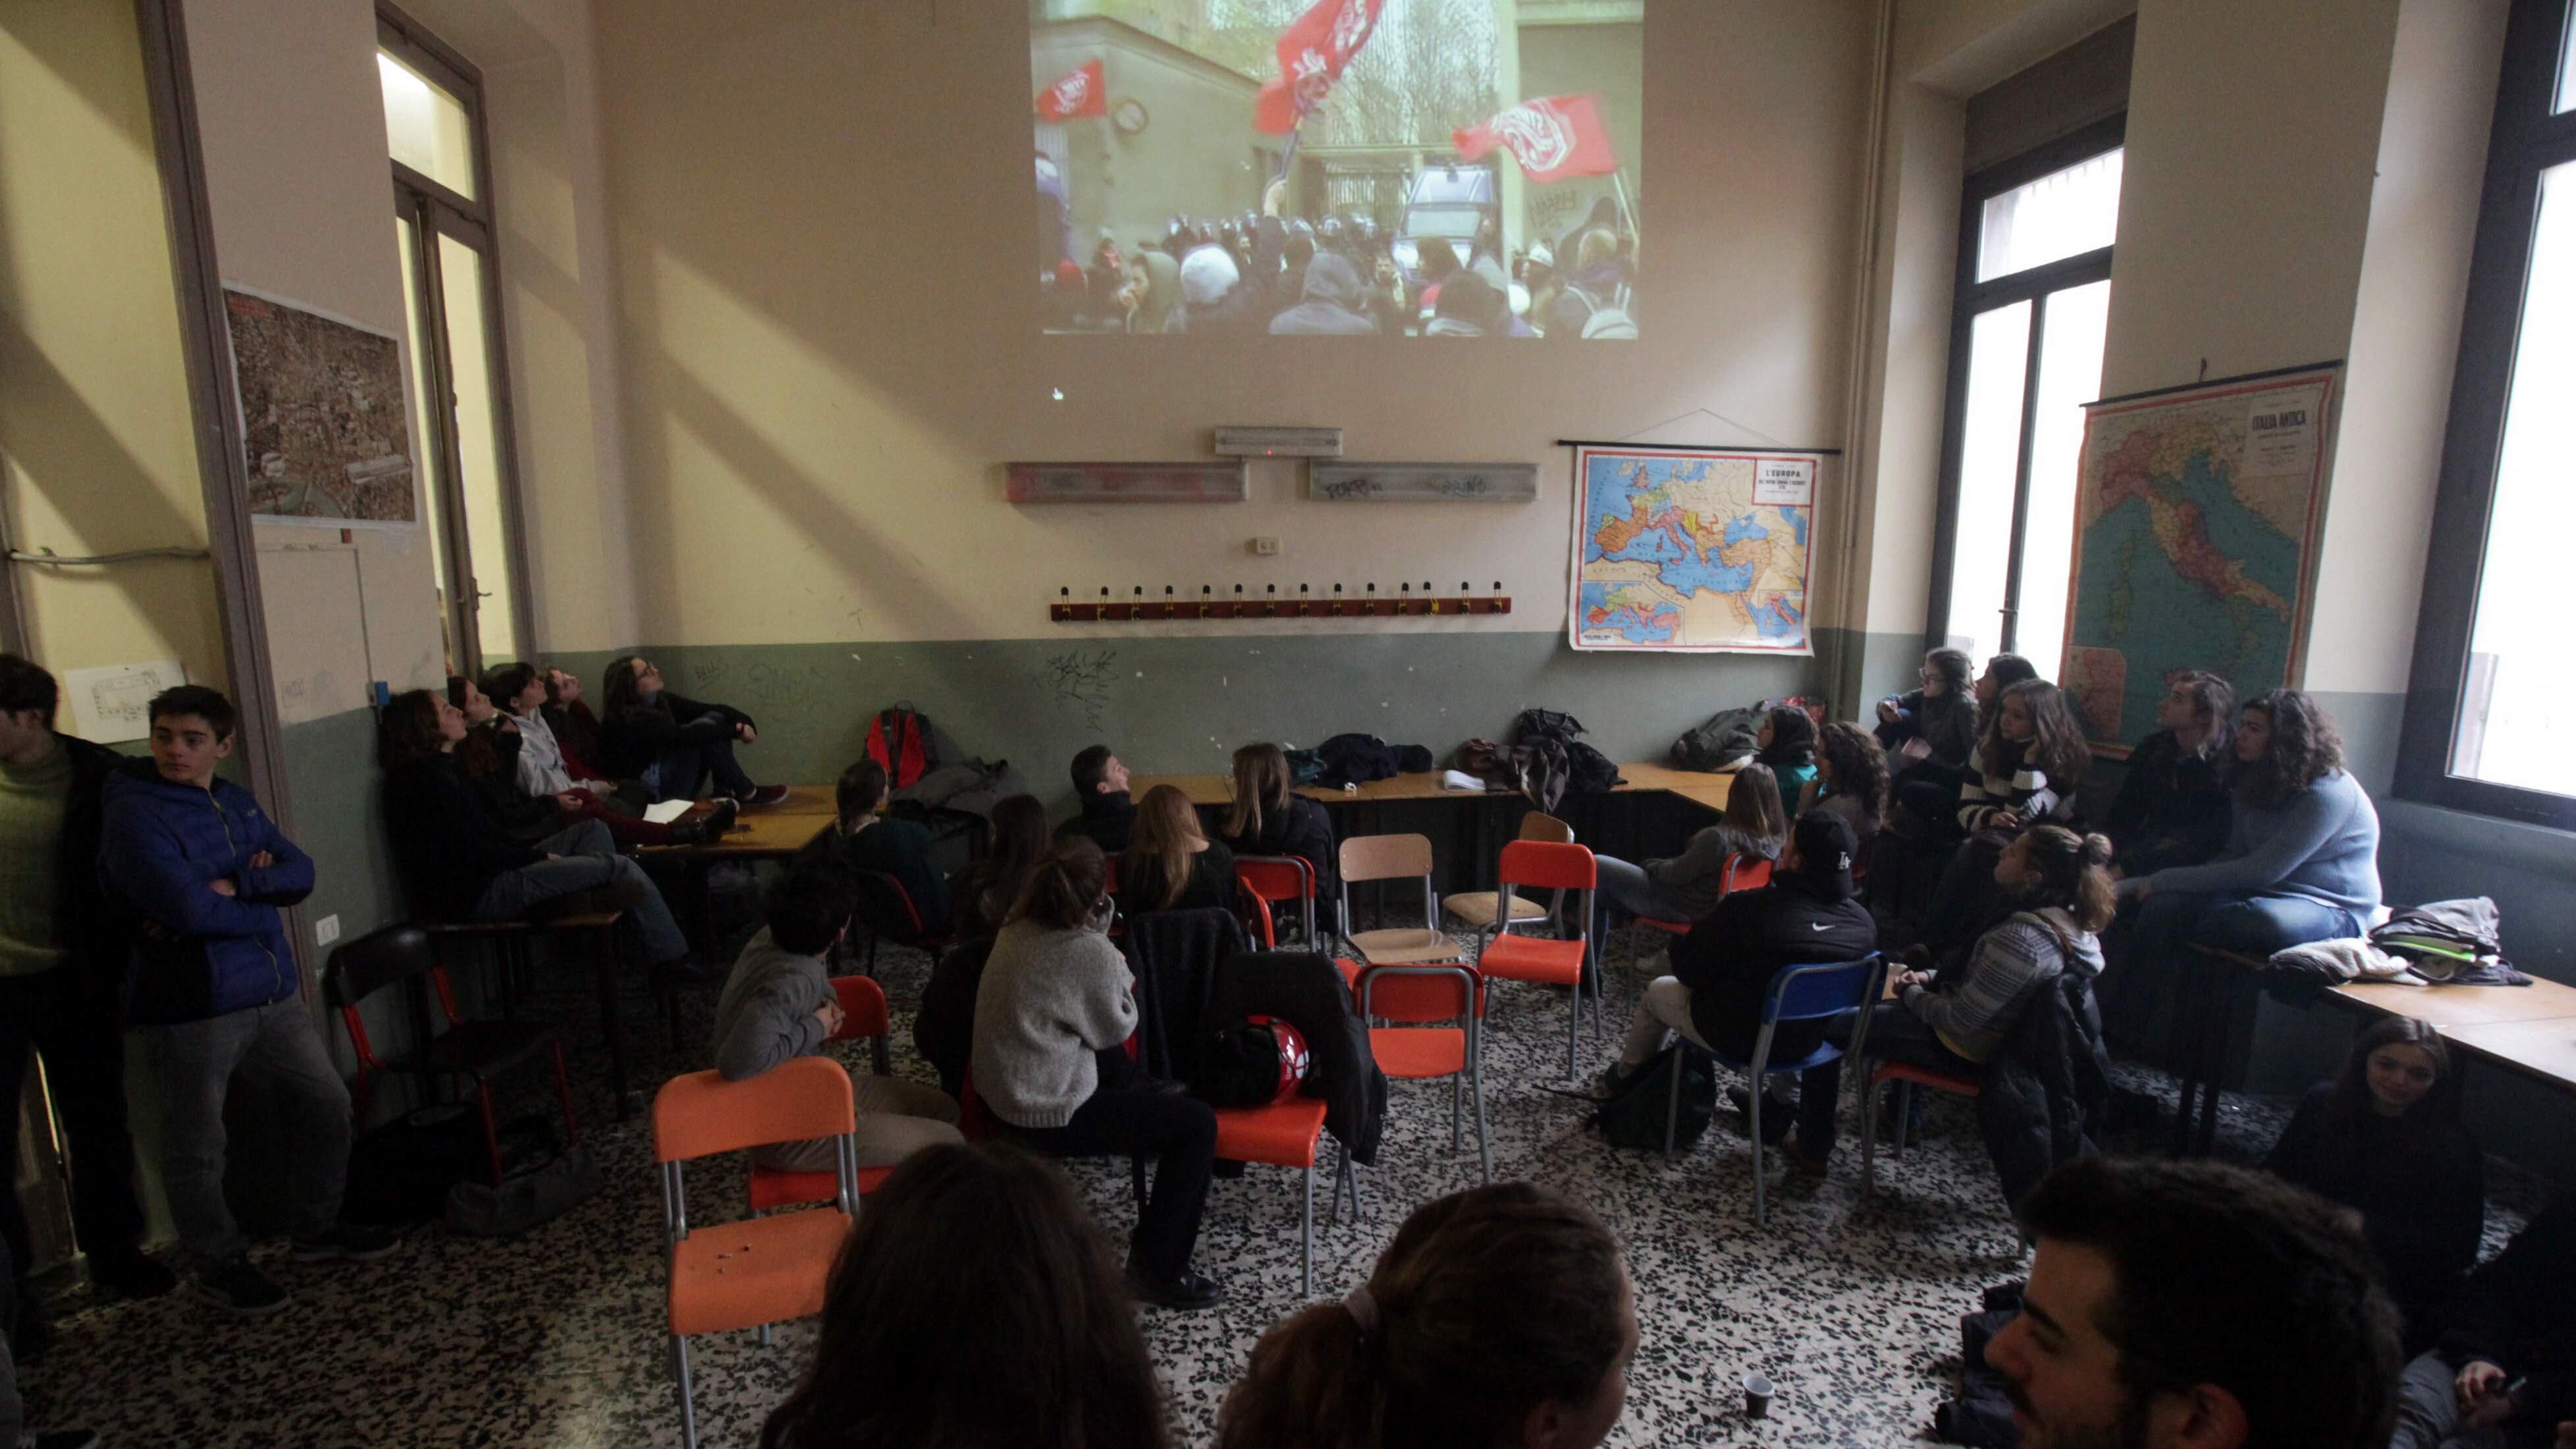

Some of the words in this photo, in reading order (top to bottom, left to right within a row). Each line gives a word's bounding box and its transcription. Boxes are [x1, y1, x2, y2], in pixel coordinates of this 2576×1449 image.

[2252, 414, 2277, 431] ITALIA
[2279, 410, 2307, 429] ANTICA
[1765, 469, 1801, 478] L'EUROPA
[1838, 851, 1852, 870] LA
